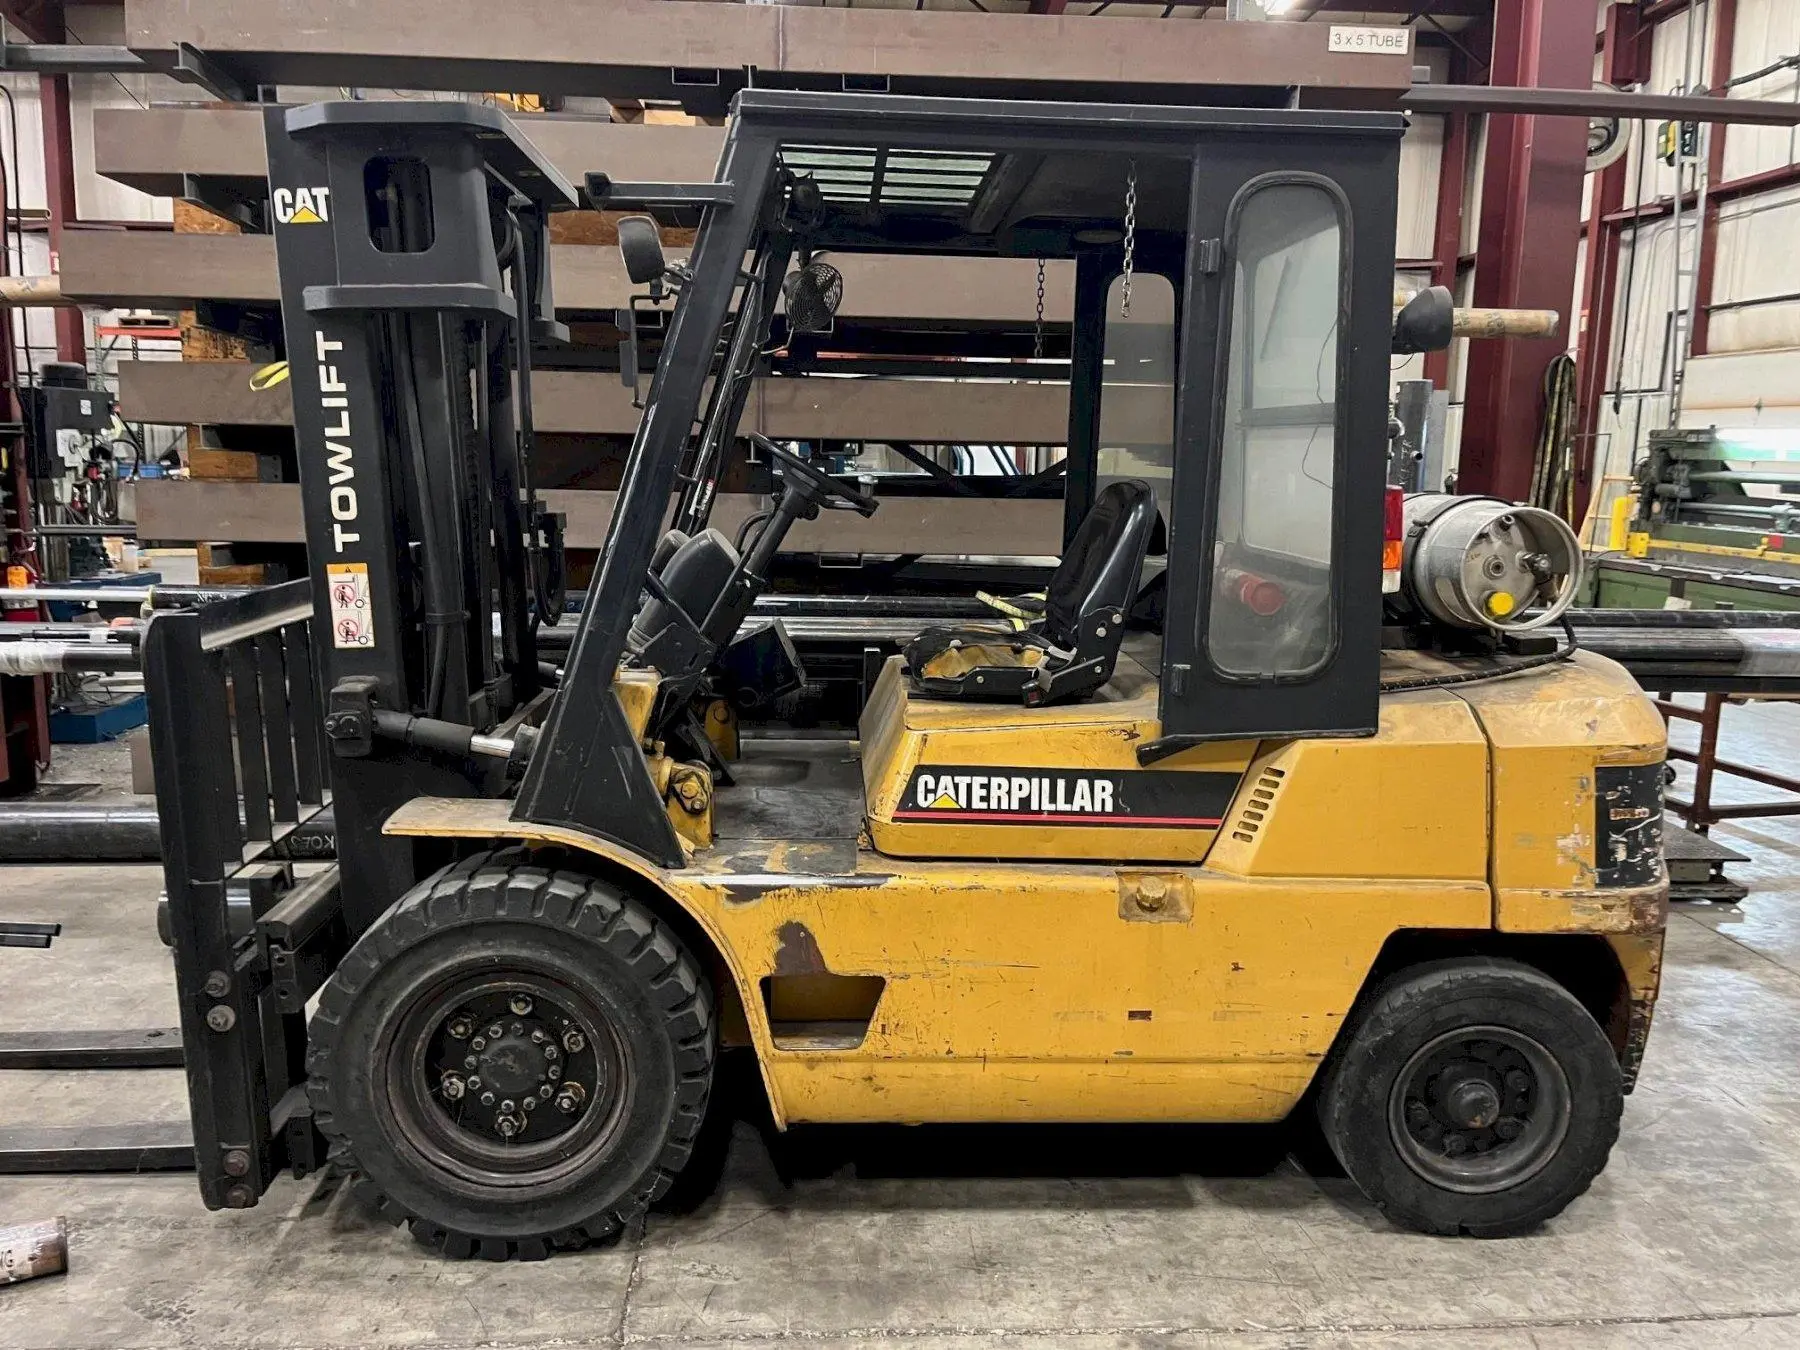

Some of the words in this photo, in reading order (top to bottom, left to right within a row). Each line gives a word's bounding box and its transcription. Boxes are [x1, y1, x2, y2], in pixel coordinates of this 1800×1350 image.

[1334, 33, 1342, 45] 3
[1345, 36, 1352, 46] x
[1355, 34, 1364, 46] 5
[1367, 34, 1404, 47] TUBE
[273, 187, 330, 224] CAT
[315, 331, 360, 553] TOWLIFT
[917, 774, 1114, 812] CATERPILLAR
